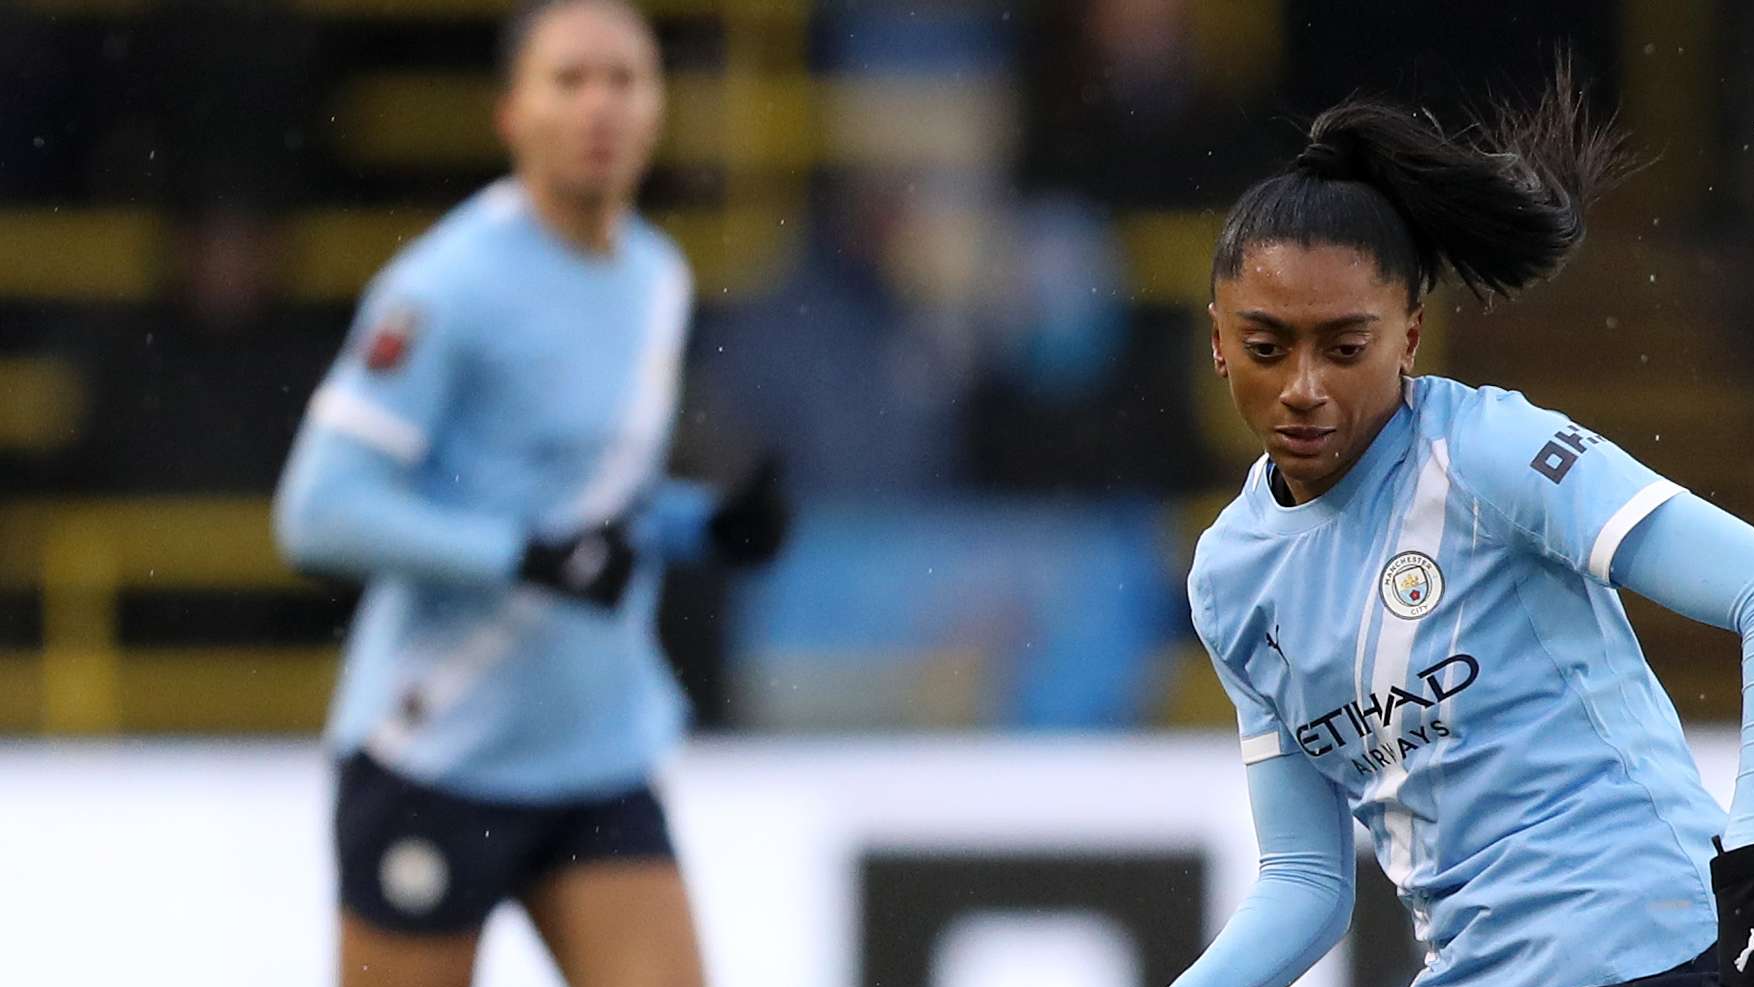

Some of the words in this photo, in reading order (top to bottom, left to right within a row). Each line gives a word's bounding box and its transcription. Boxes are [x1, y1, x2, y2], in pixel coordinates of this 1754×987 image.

[1530, 424, 1607, 485] OK
[1384, 556, 1433, 586] MANCHESTER
[1410, 604, 1429, 616] CITY
[1296, 653, 1481, 758] ETIHAD
